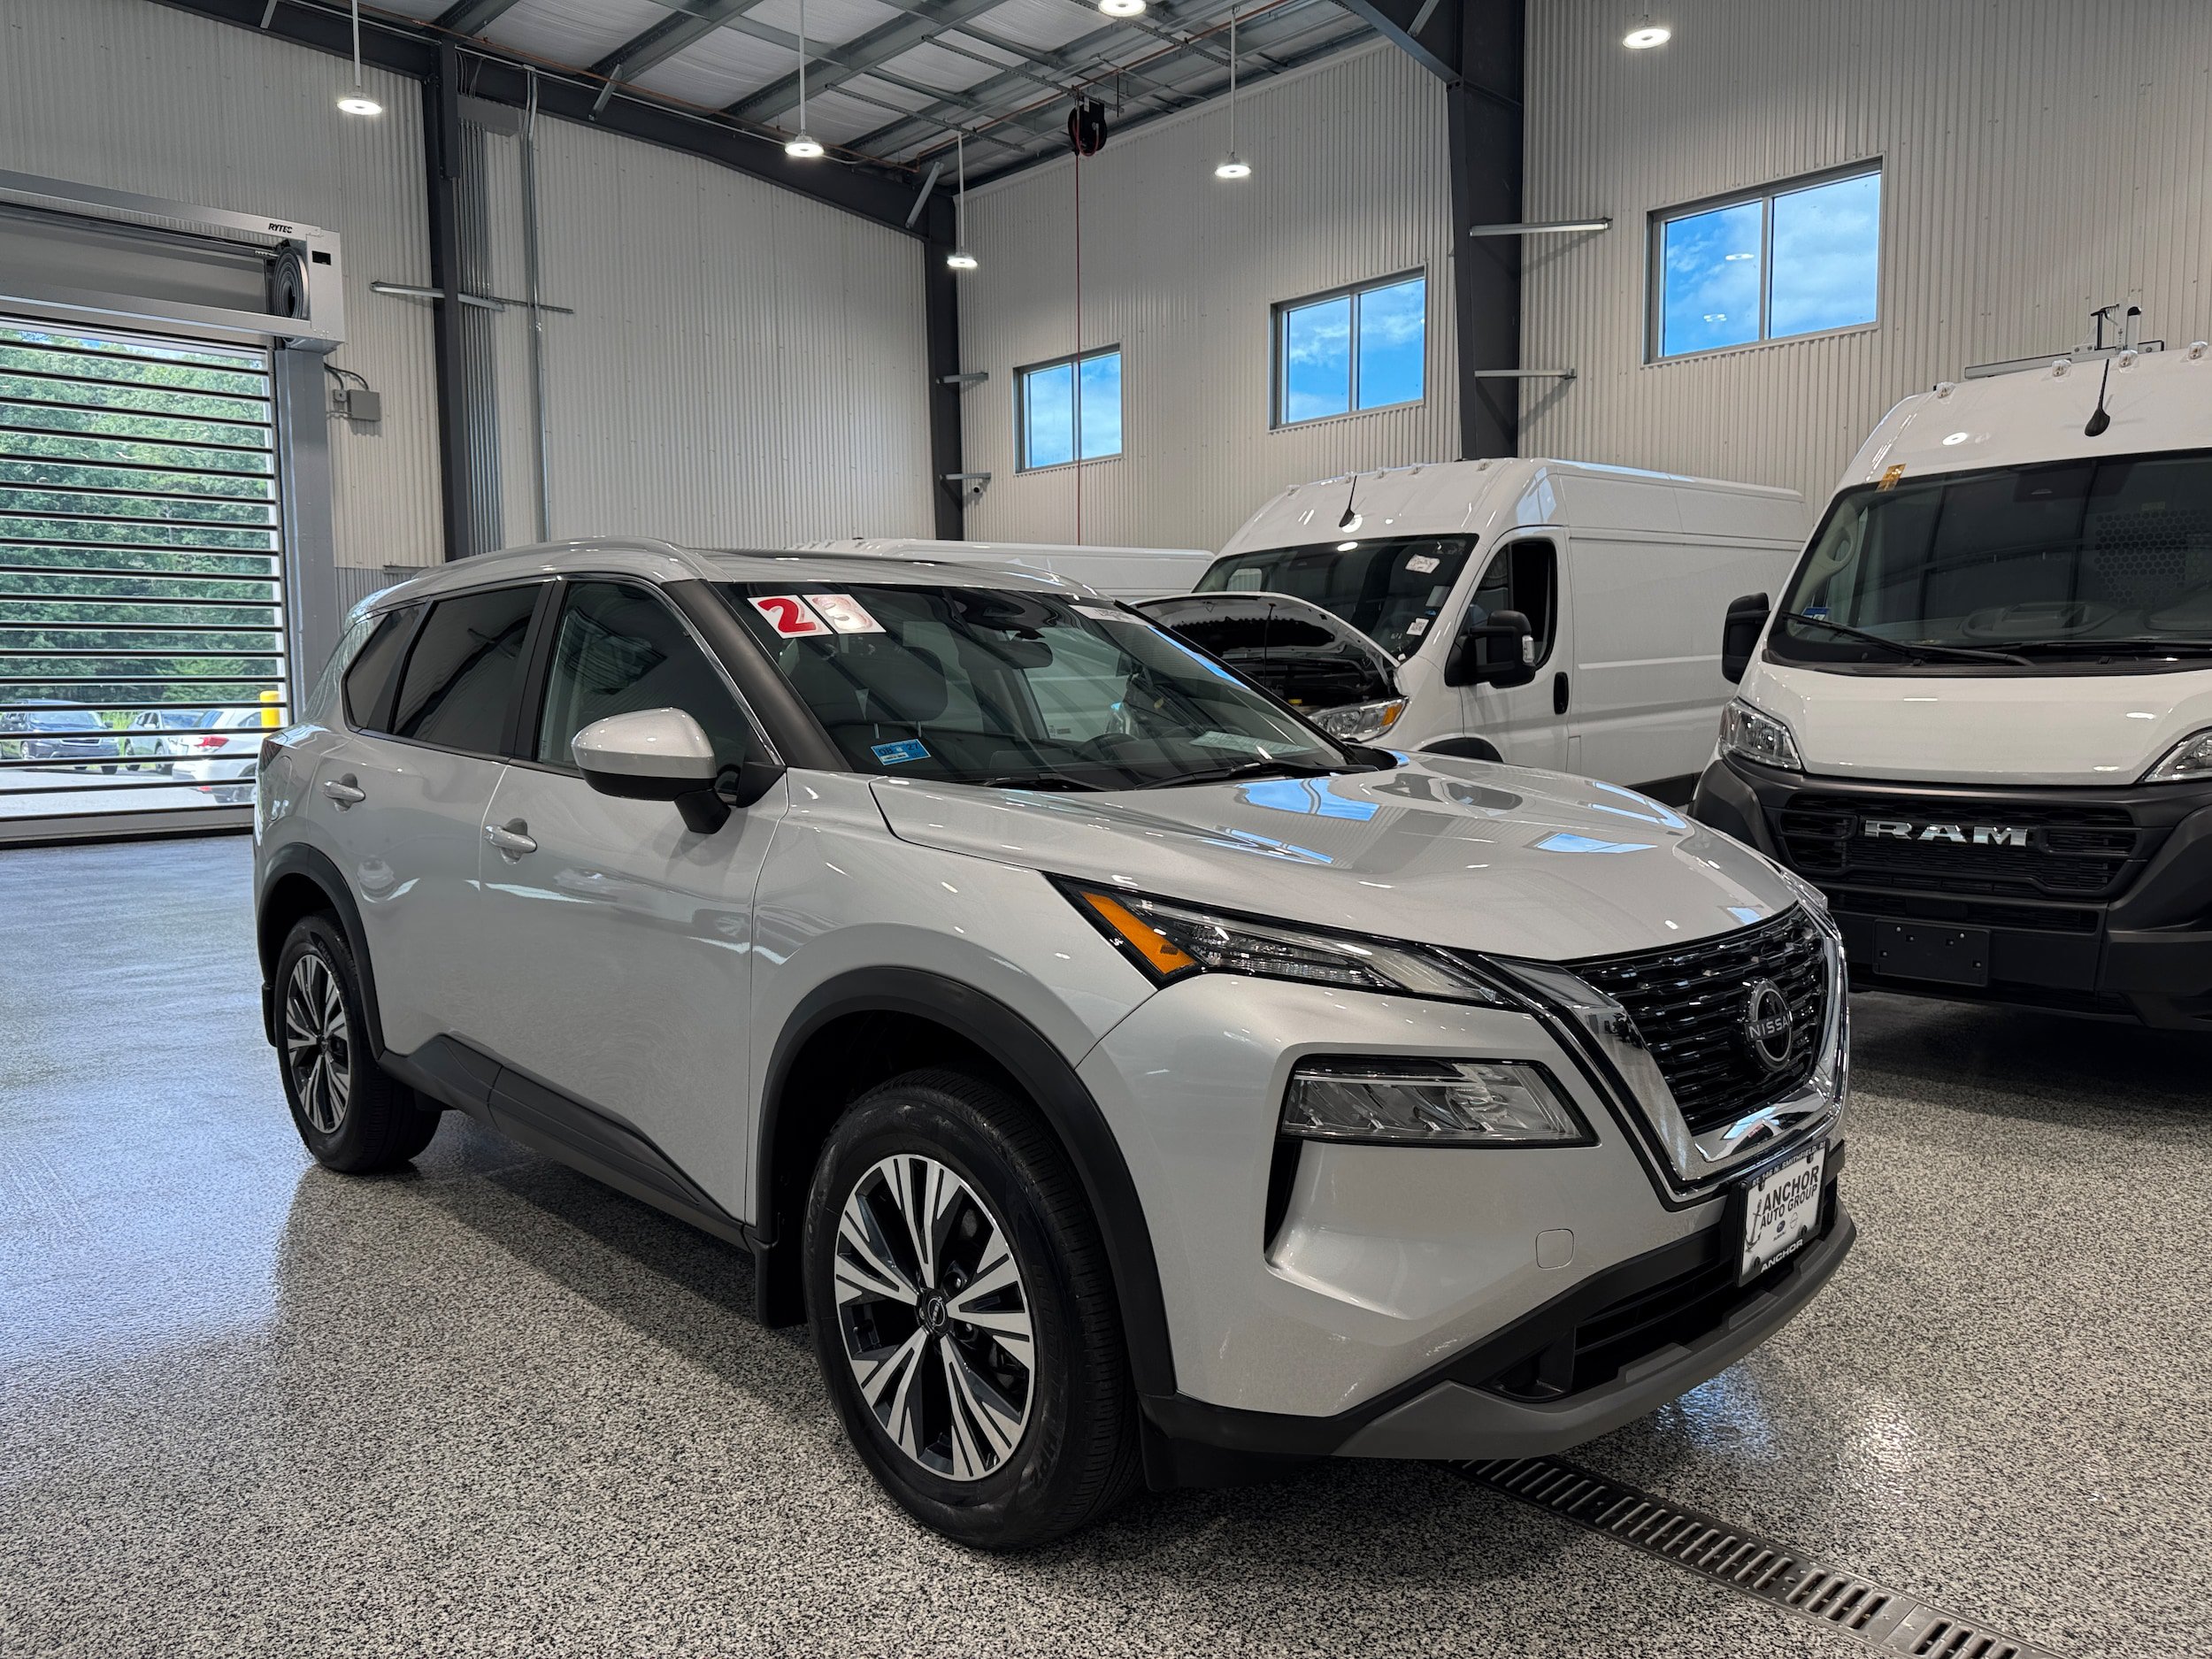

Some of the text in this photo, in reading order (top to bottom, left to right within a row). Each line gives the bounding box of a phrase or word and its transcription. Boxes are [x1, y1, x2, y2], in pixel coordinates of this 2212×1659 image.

[268, 223, 293, 234] RYTEC
[1864, 819, 2028, 847] RAM
[1760, 1183, 1817, 1231] AUTO GROUP
[1763, 1165, 1820, 1215] ANCHOR
[1760, 1239, 1803, 1273] ANCHOR
